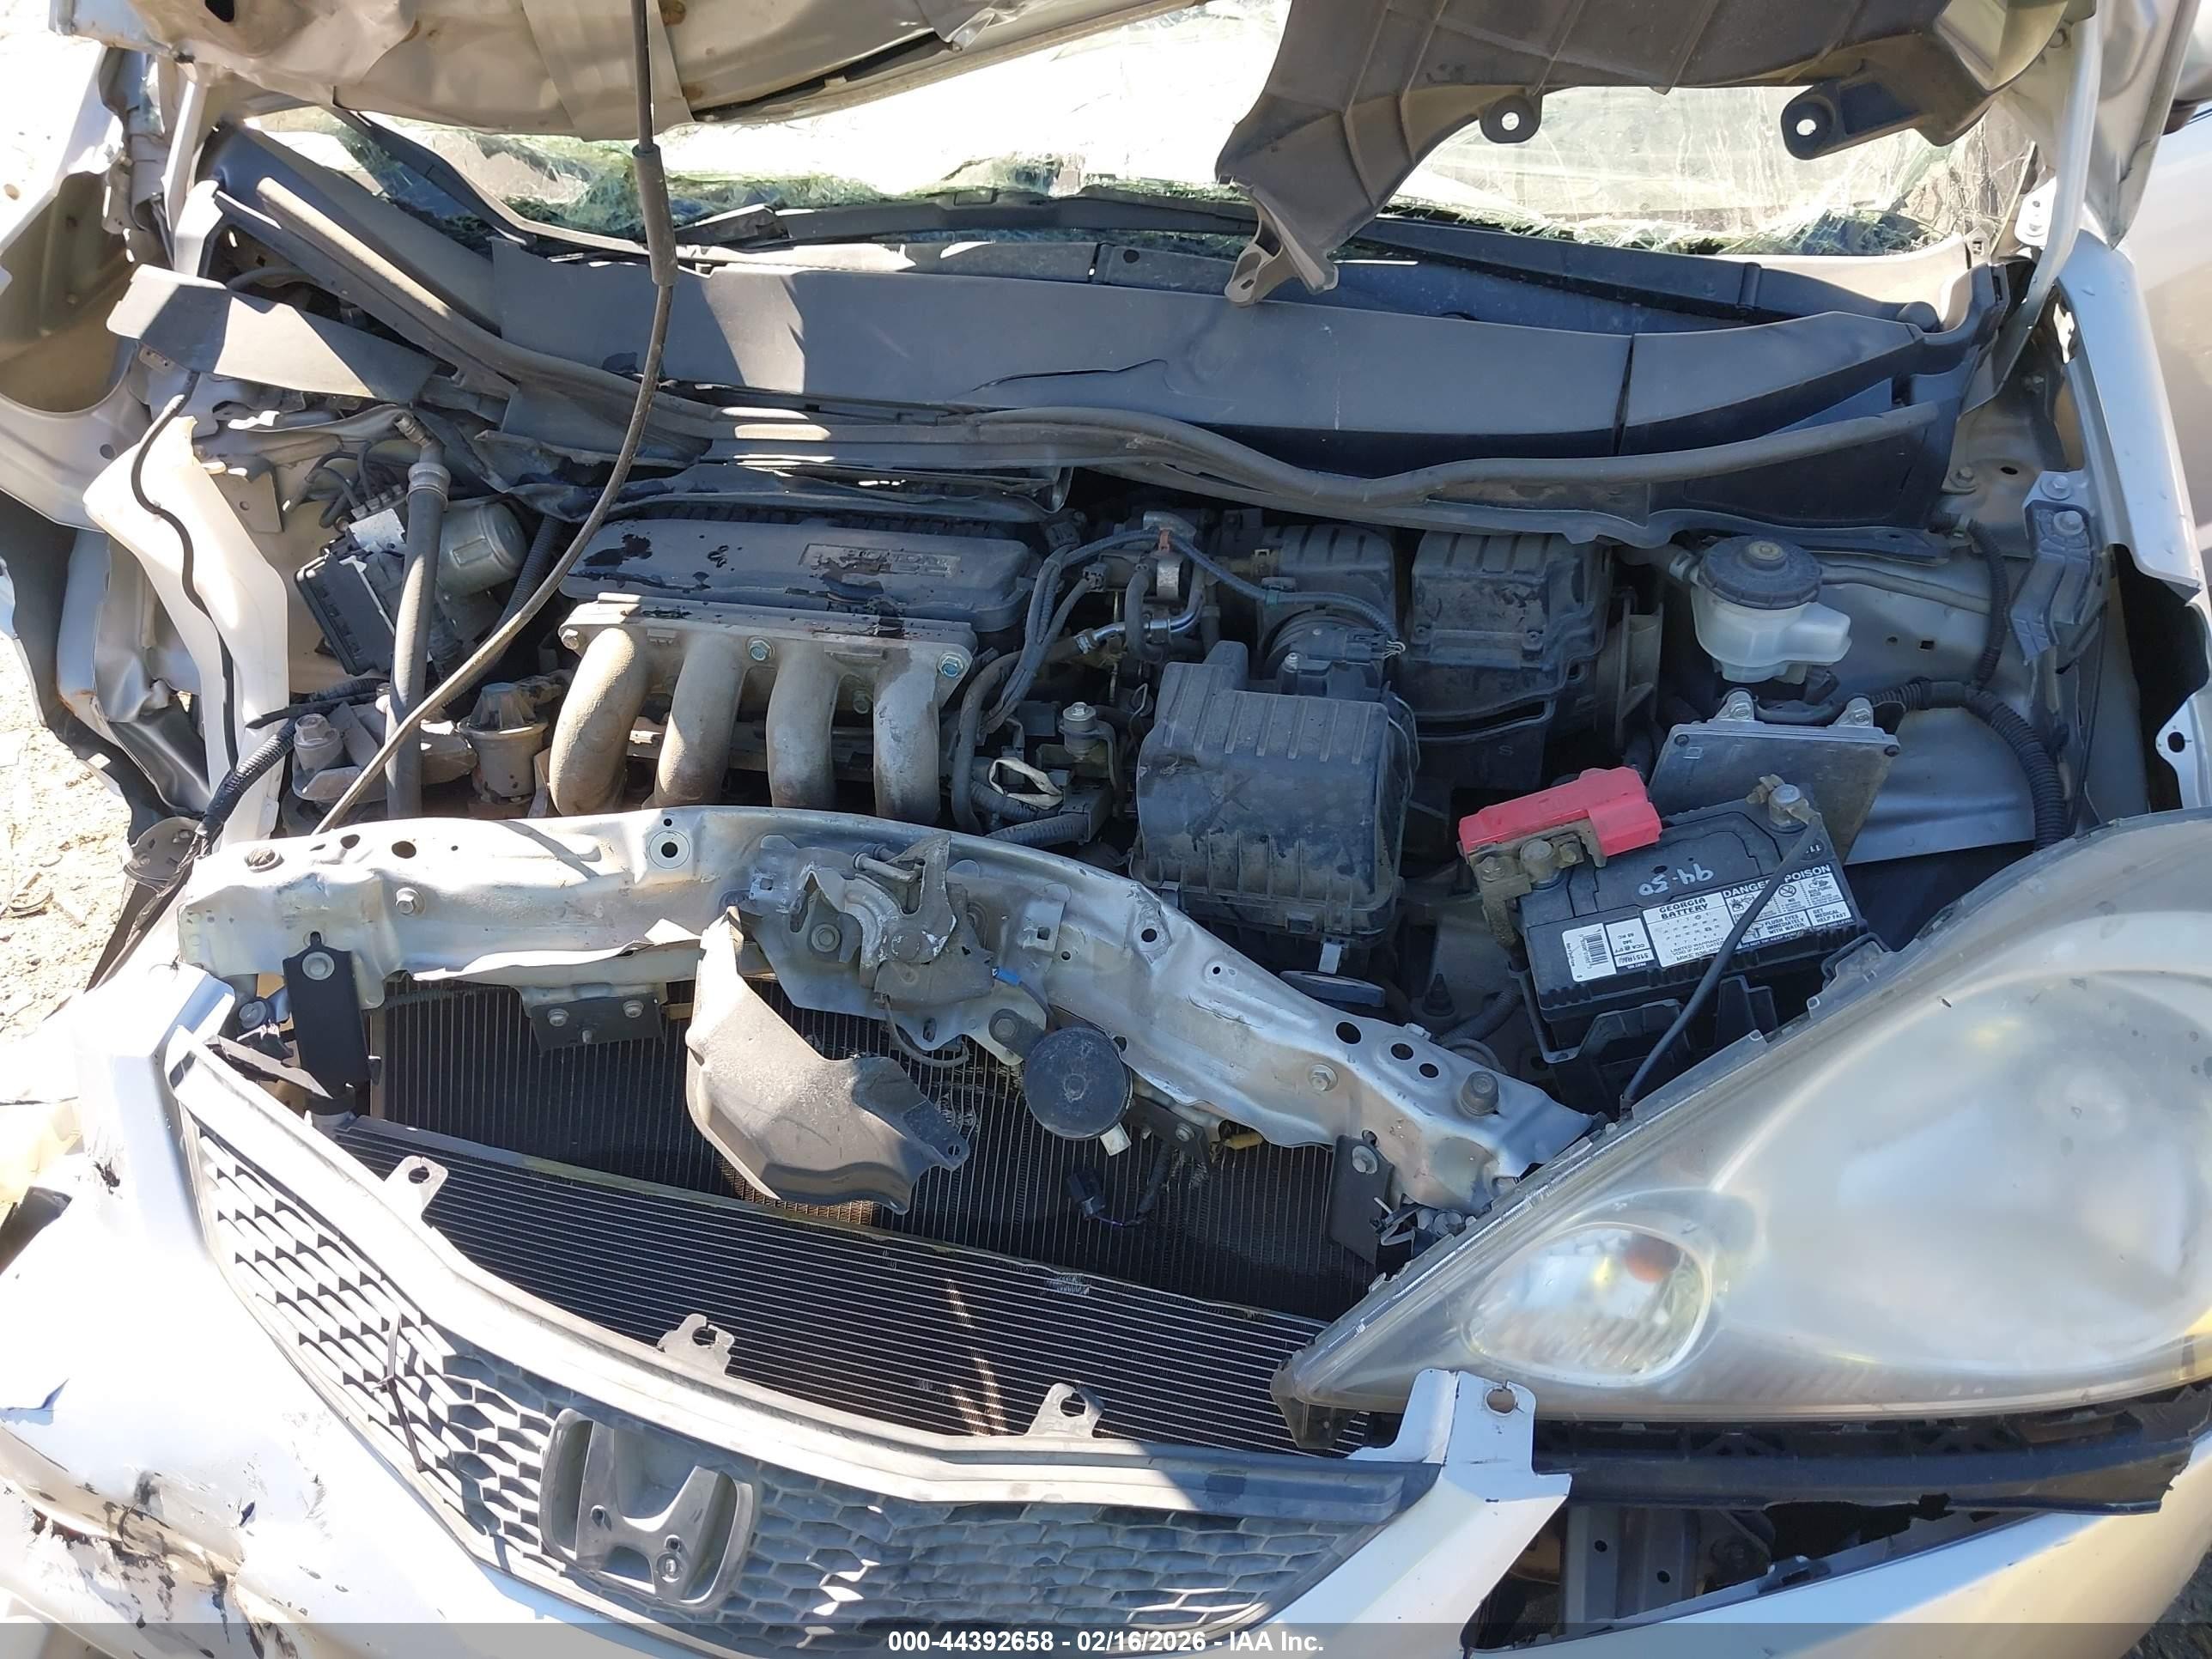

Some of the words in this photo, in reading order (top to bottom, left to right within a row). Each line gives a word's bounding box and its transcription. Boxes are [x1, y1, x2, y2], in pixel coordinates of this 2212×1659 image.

[1784, 864, 1832, 883] POISON
[1659, 897, 1706, 913] GEORGIA
[1661, 903, 1709, 919] BATTERY
[1815, 909, 1839, 918] MEDICAL
[1766, 918, 1805, 930] IMMEDIATELY
[1670, 945, 1692, 953] LIMITED
[1692, 937, 1724, 947] WARRANTY
